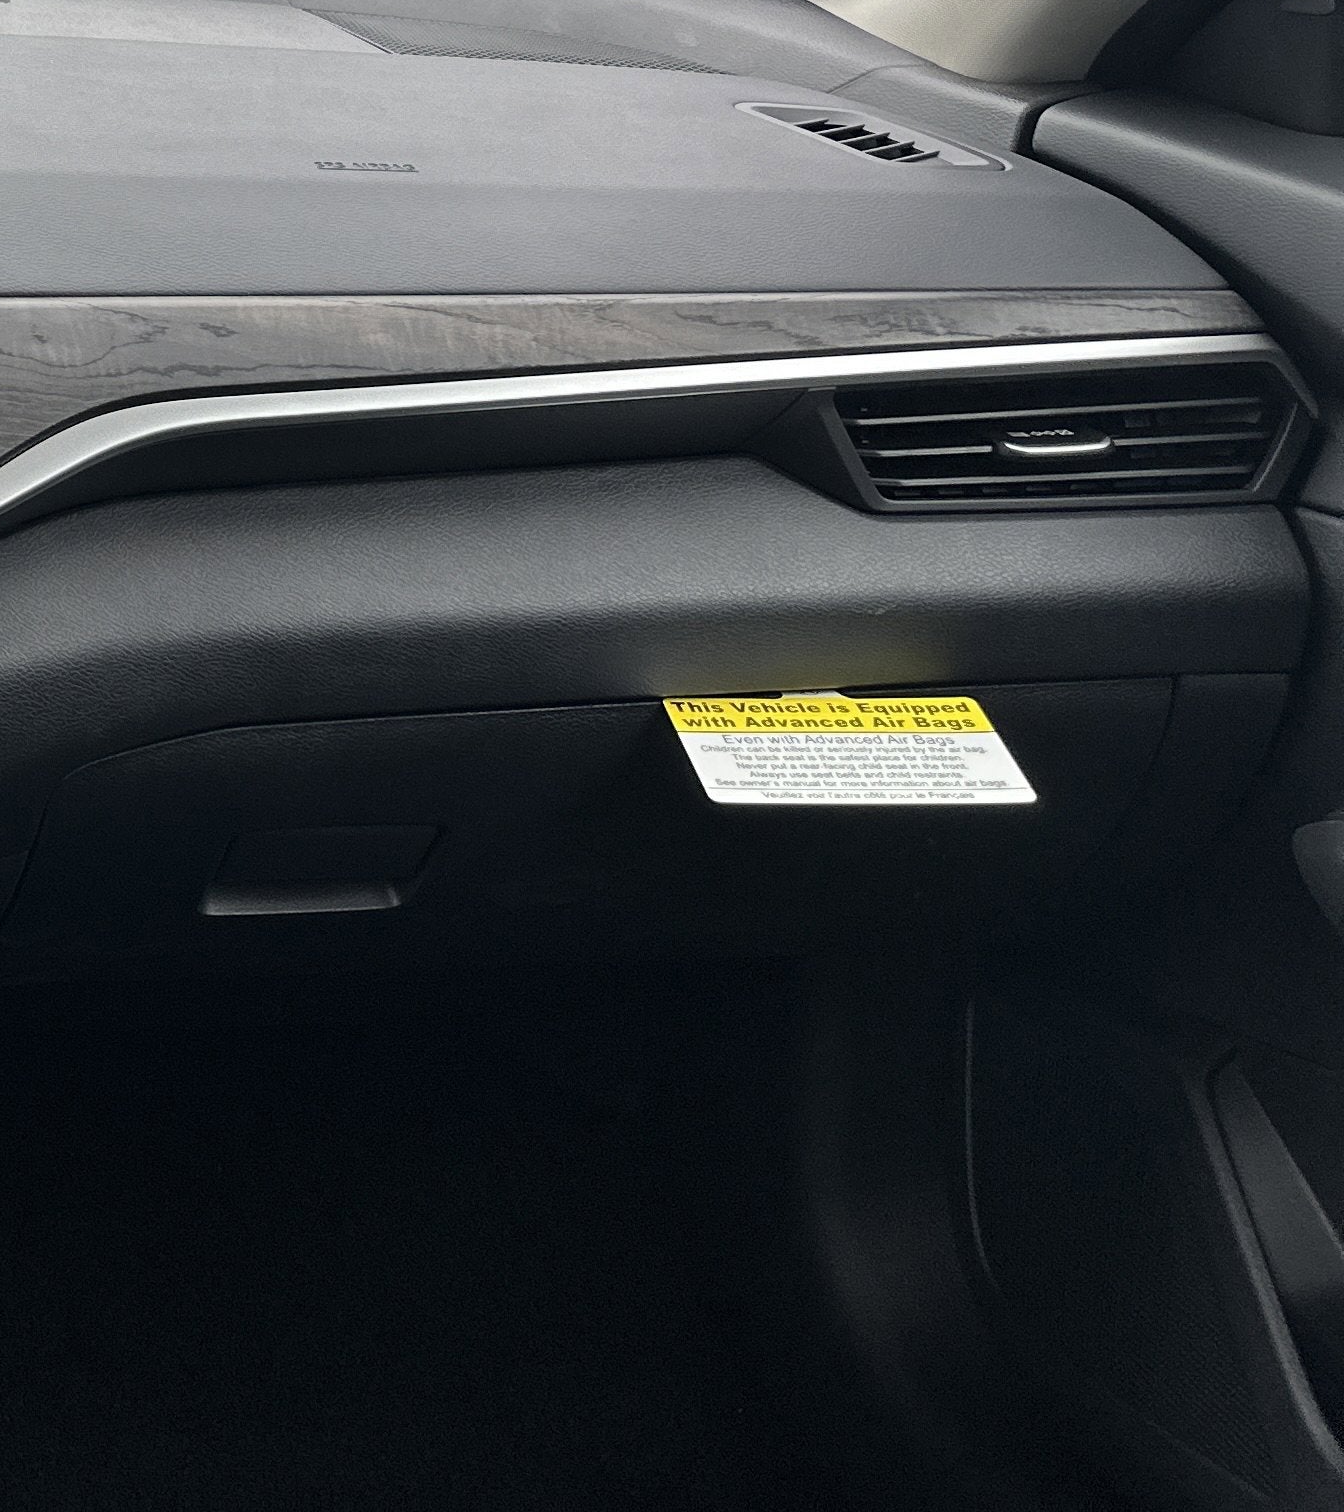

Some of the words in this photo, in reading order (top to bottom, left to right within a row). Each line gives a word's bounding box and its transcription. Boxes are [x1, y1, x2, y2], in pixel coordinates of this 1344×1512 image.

[670, 701, 725, 713] This
[729, 701, 821, 713] Vehicle
[826, 702, 850, 713] is
[855, 701, 971, 715] Equipped
[682, 716, 736, 728] with
[746, 716, 864, 728] Advanced
[873, 716, 905, 728] Air
[912, 716, 976, 730] Bags
[722, 734, 764, 745] Even
[767, 734, 800, 744] with
[805, 734, 883, 745] Advanced
[888, 734, 908, 745] Air
[912, 734, 955, 747] Bags
[700, 744, 745, 753] Children
[767, 745, 781, 753] be
[783, 745, 811, 753] killed
[827, 745, 873, 754] seriously
[876, 745, 911, 754] injured
[913, 745, 926, 754] by
[928, 745, 945, 753] the
[949, 745, 961, 753] air
